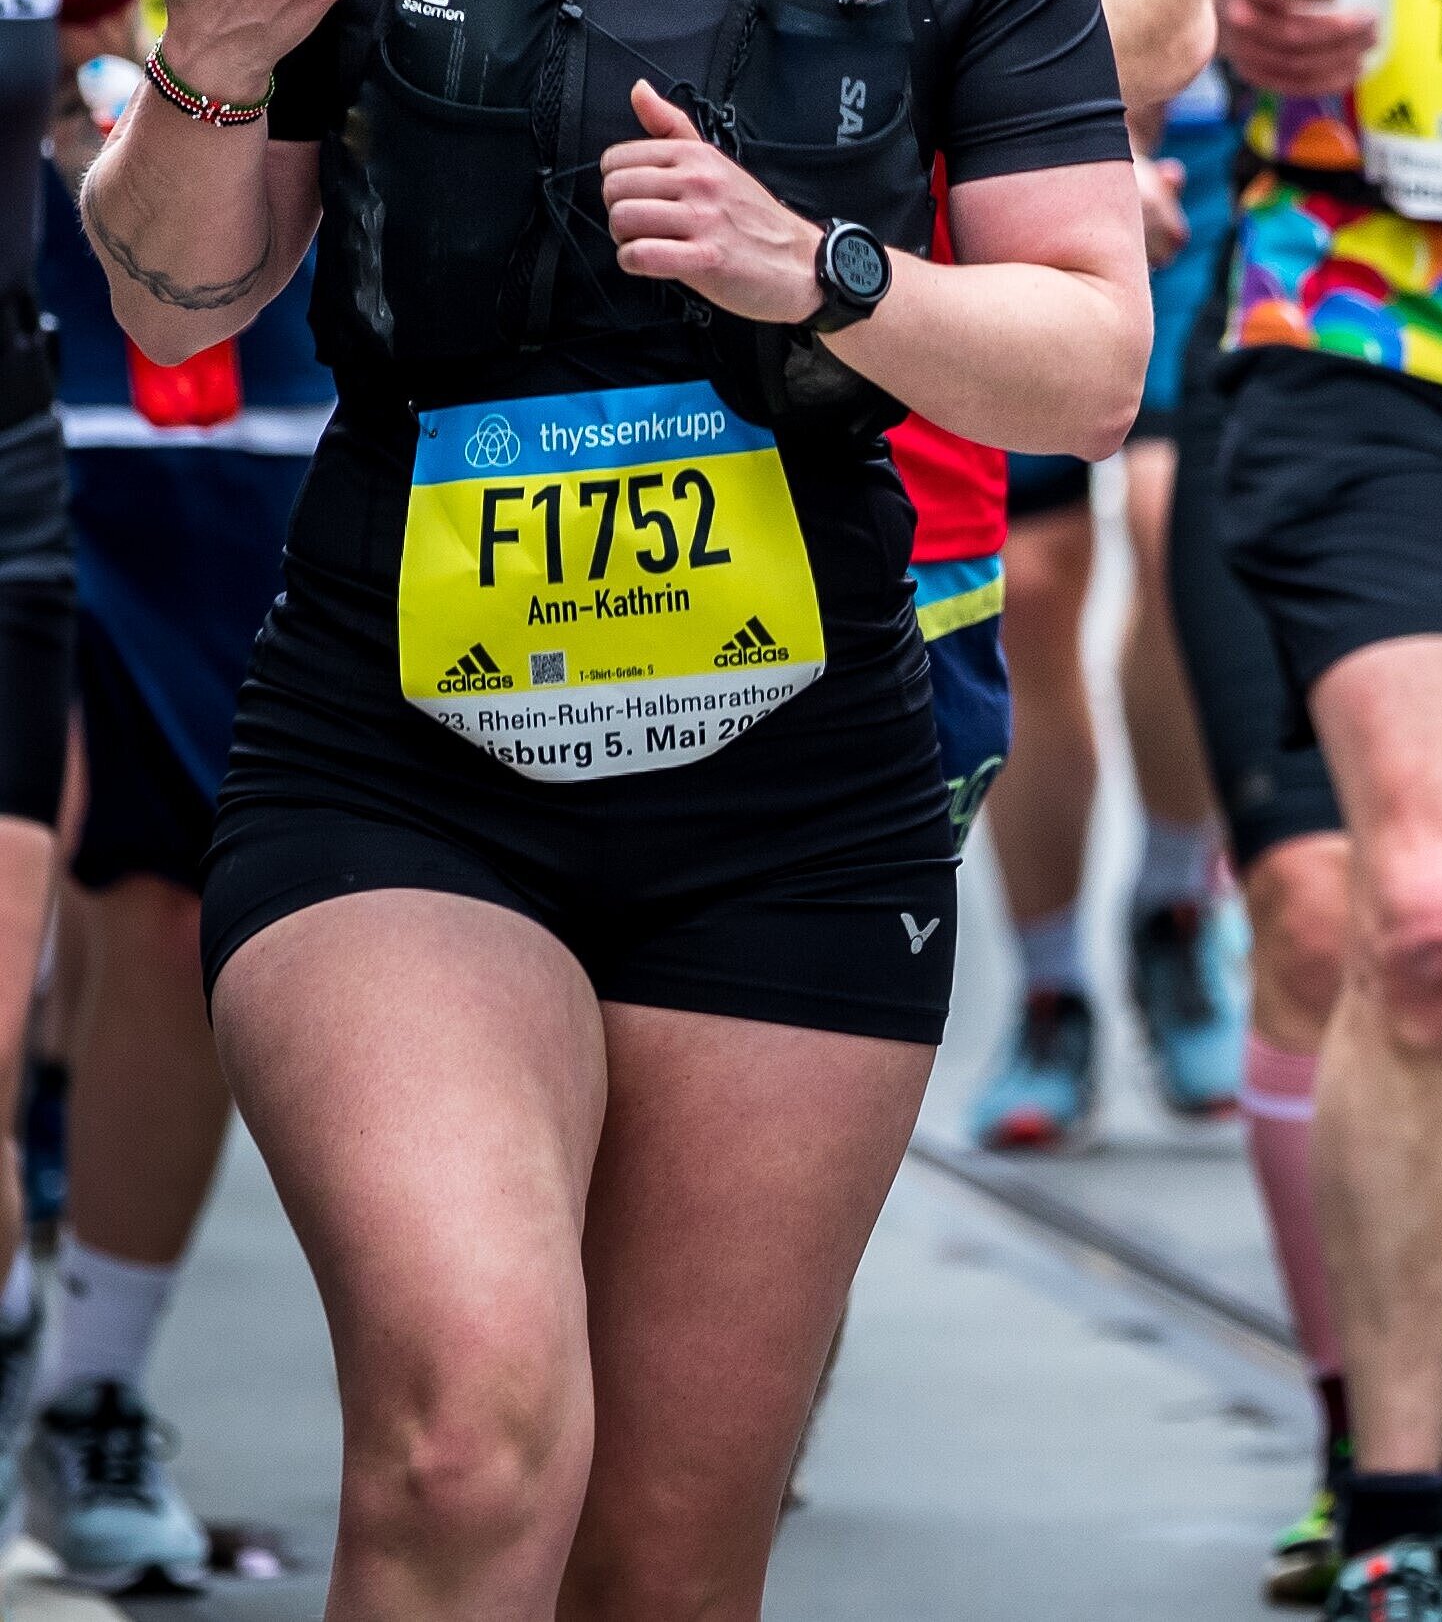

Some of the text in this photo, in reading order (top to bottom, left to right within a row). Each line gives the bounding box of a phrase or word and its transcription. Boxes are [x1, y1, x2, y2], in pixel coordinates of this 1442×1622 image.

[540, 409, 726, 456] thyssenkrupp
[479, 468, 732, 588] F1752
[527, 582, 691, 626] Ann-Kathrin
[714, 644, 790, 668] adidas
[436, 674, 514, 694] adidas
[478, 683, 795, 732] Rhein-Ruhr-Halbmarathon
[604, 731, 633, 758] 5.
[645, 720, 706, 754] Mai
